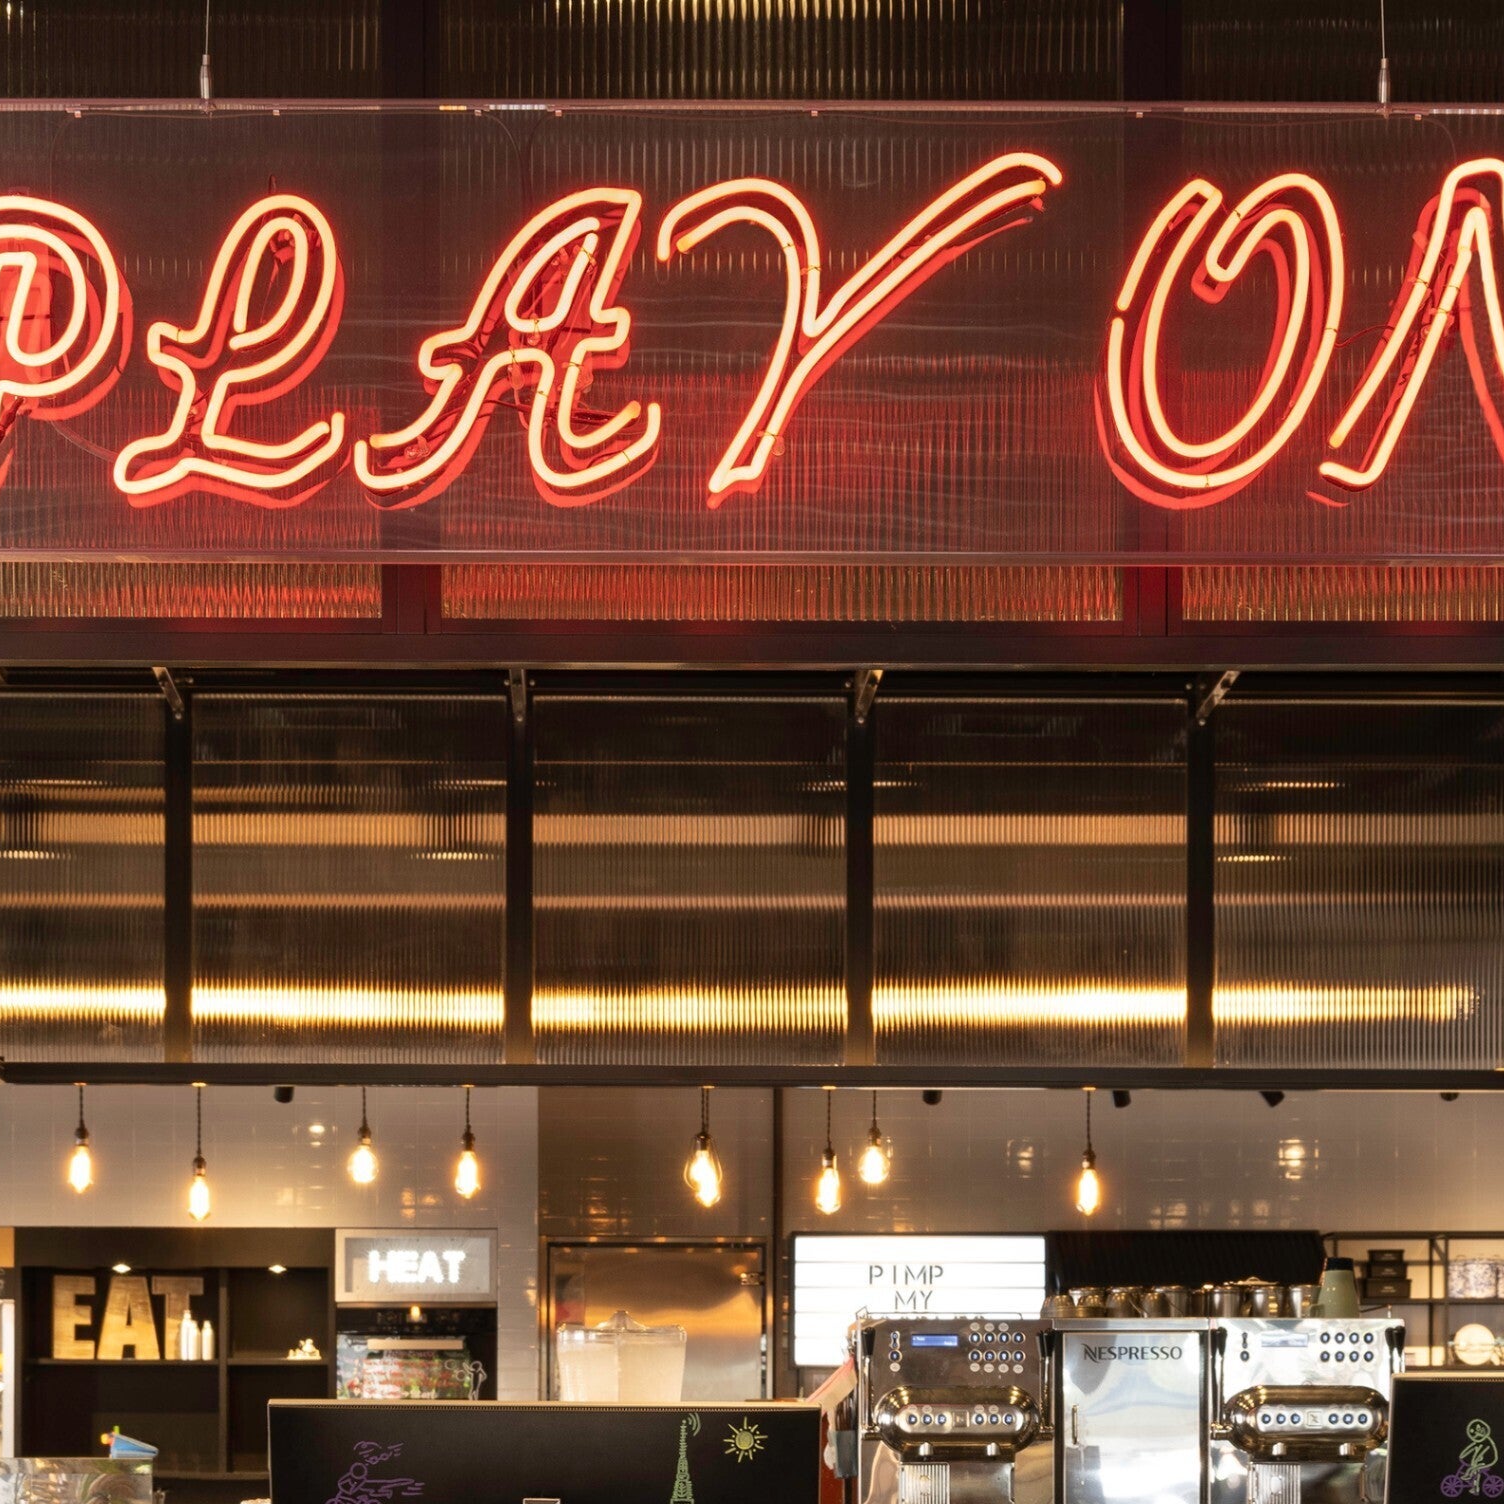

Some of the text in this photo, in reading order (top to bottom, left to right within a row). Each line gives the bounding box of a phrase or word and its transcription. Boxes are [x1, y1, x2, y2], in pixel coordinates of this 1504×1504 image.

[367, 1249, 466, 1284] HEAT
[868, 1264, 944, 1285] PIMP
[894, 1290, 934, 1311] MY
[52, 1275, 204, 1360] EAT
[1082, 1342, 1183, 1364] NESPRESSO
